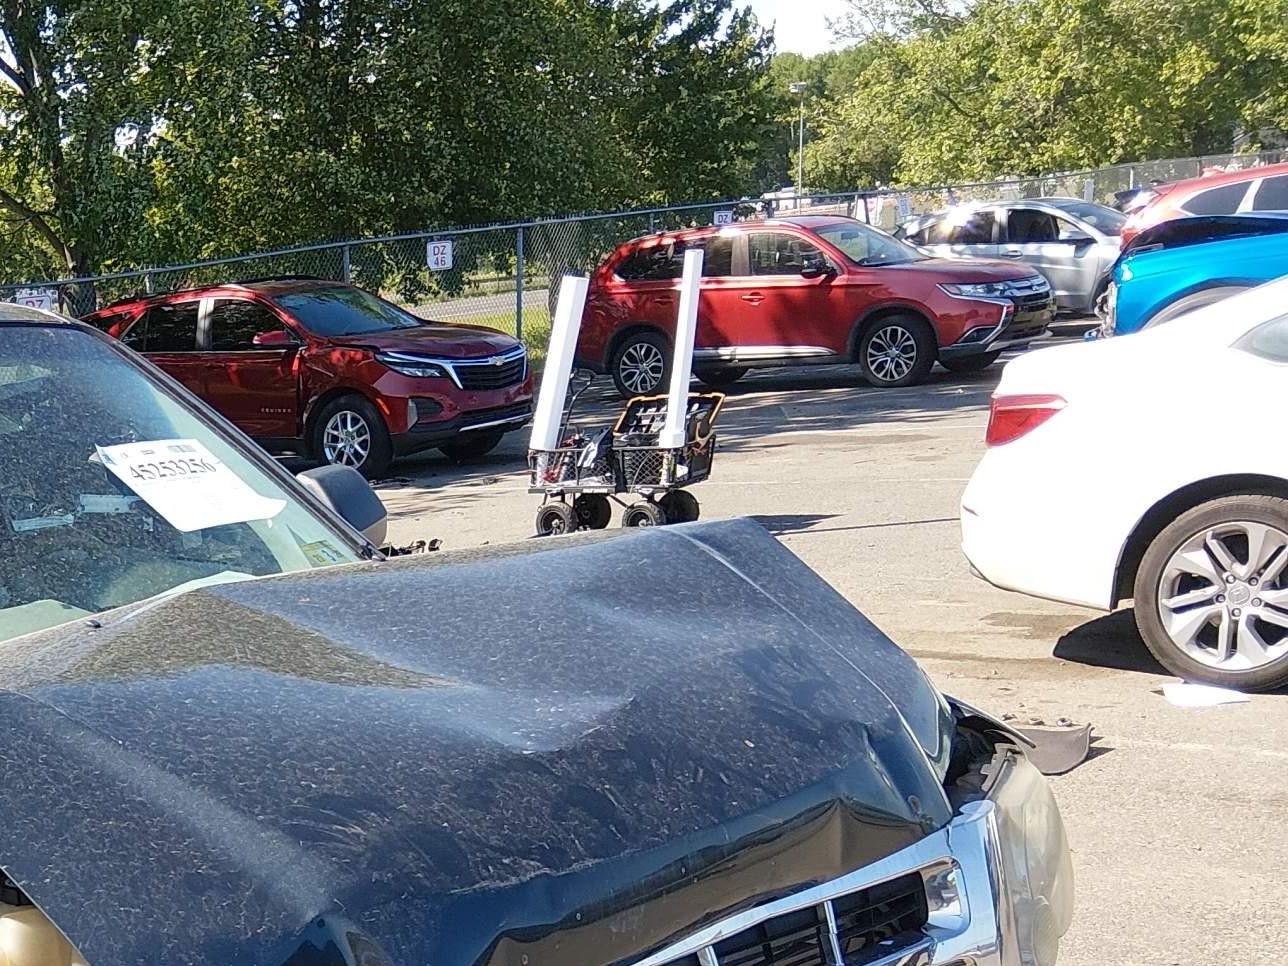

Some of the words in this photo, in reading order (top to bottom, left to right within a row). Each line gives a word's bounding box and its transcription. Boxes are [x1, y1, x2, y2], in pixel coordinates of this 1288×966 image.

[433, 245, 447, 256] DZ
[433, 256, 447, 267] 46
[129, 458, 217, 480] 45253256
